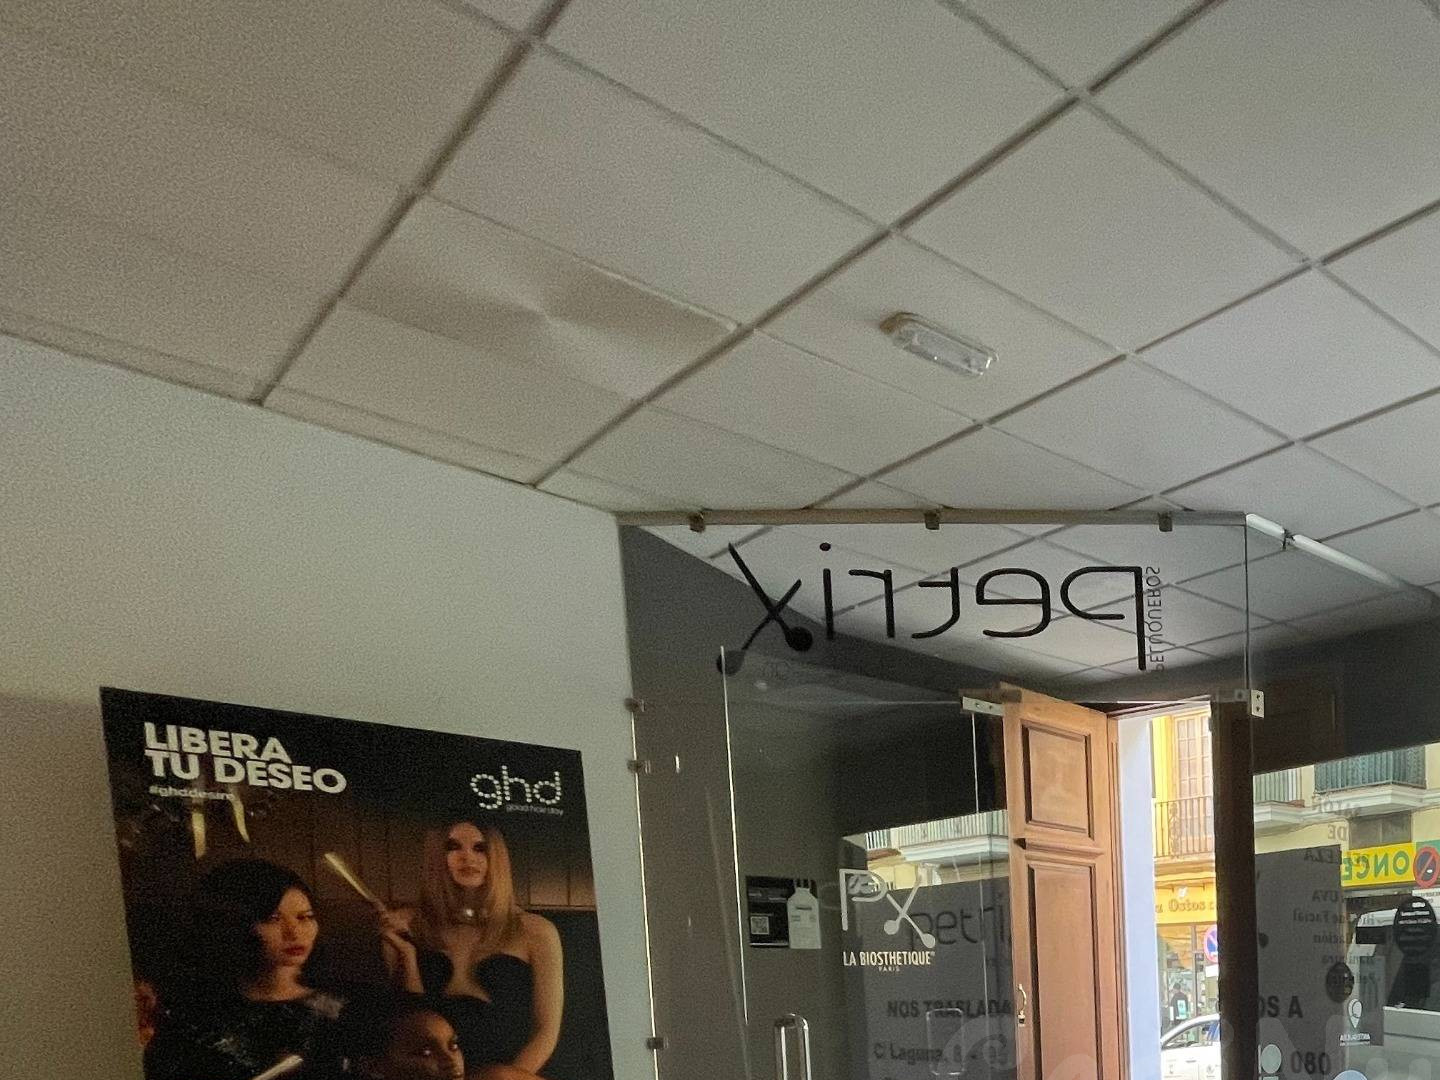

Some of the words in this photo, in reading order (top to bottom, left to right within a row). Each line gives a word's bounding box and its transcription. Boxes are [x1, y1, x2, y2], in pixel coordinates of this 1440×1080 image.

[144, 721, 292, 764] LIBERA
[144, 749, 200, 780] TU
[213, 756, 347, 794] DESEO
[469, 765, 562, 810] ghd
[843, 951, 857, 966] LA
[887, 1000, 919, 1018] NOS
